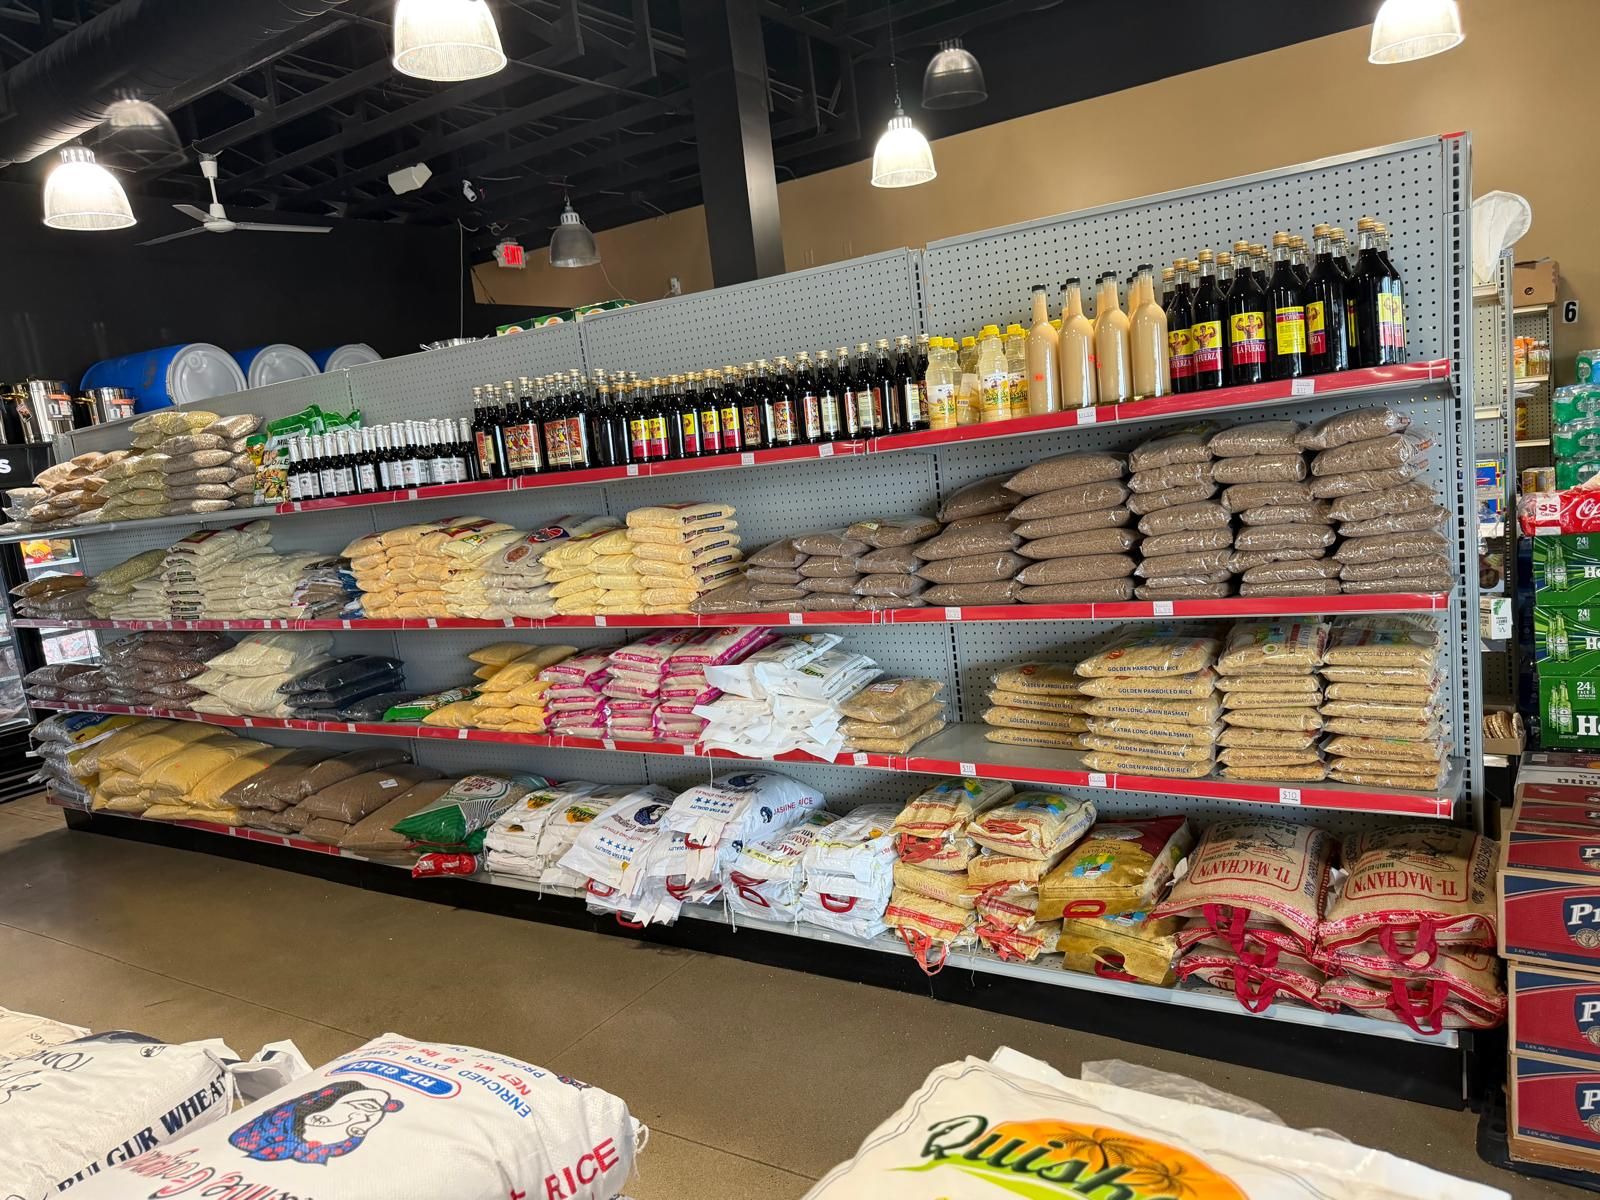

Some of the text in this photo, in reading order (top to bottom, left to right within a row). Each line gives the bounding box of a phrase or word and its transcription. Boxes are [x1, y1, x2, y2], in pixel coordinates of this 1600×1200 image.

[1564, 301, 1577, 323] 6
[1576, 681, 1591, 691] 24
[1168, 731, 1194, 739] BASMATI
[1138, 746, 1172, 755] PARBOILED
[1141, 765, 1175, 773] PARBOILED
[1282, 790, 1298, 801] $10
[1200, 858, 1271, 877] MACHAN'N
[1353, 871, 1457, 896] TI- MACHAN'N
[404, 1055, 454, 1071] EXTRA
[472, 1053, 546, 1079] PRODUCT
[474, 1062, 496, 1072] wt.
[400, 1071, 438, 1088] RIZ
[498, 1074, 532, 1096] NET
[159, 1070, 226, 1136] WHEAT
[458, 1069, 532, 1119] ENRICHED
[544, 1137, 620, 1200] RICE
